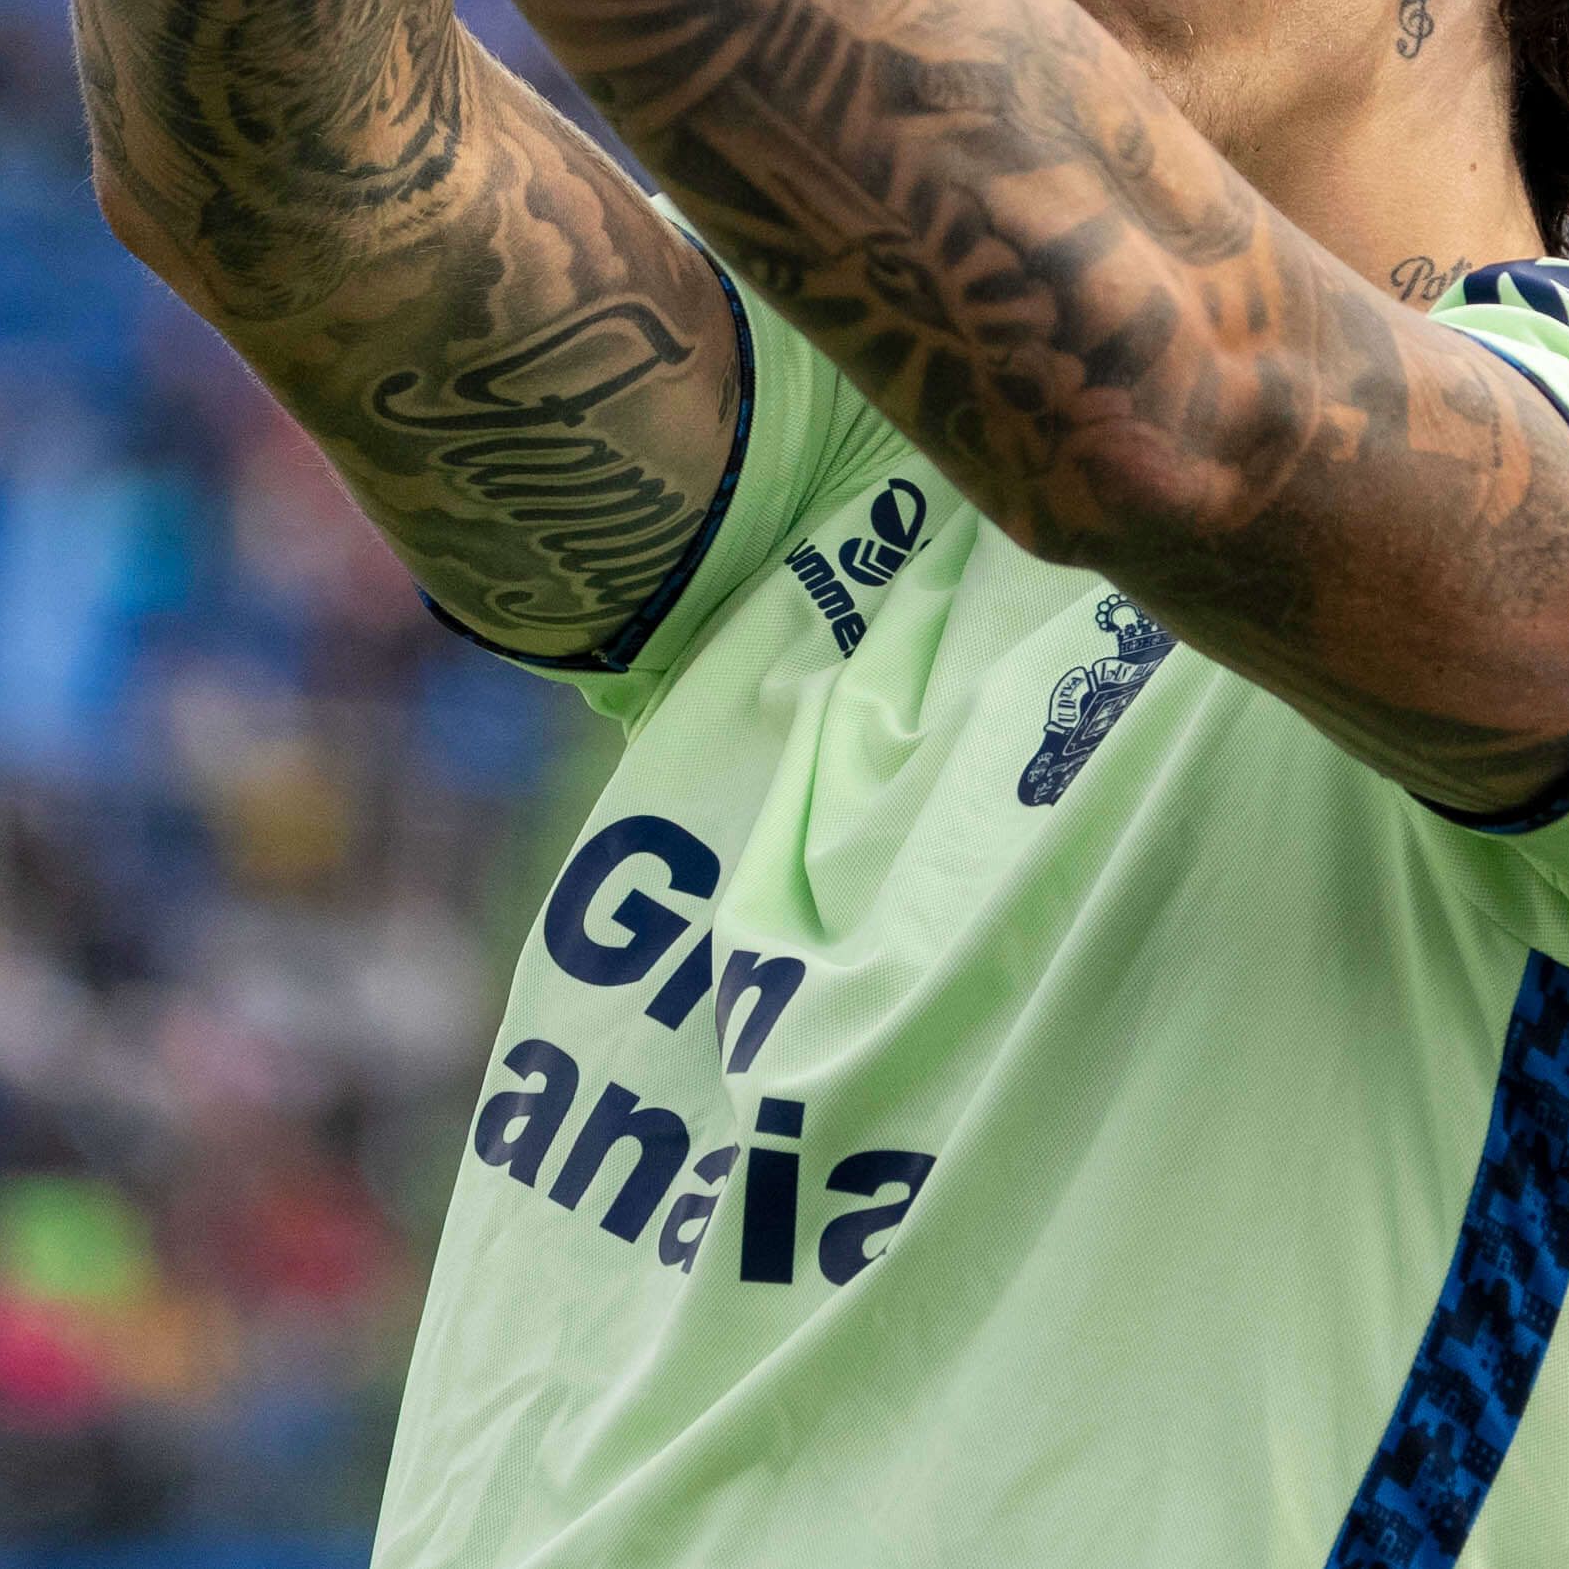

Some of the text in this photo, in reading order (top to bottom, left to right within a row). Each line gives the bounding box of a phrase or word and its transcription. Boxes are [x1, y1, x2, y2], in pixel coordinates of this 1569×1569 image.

[783, 537, 868, 660] umme
[543, 814, 808, 1076] Gn
[473, 1037, 938, 1288] anaia
